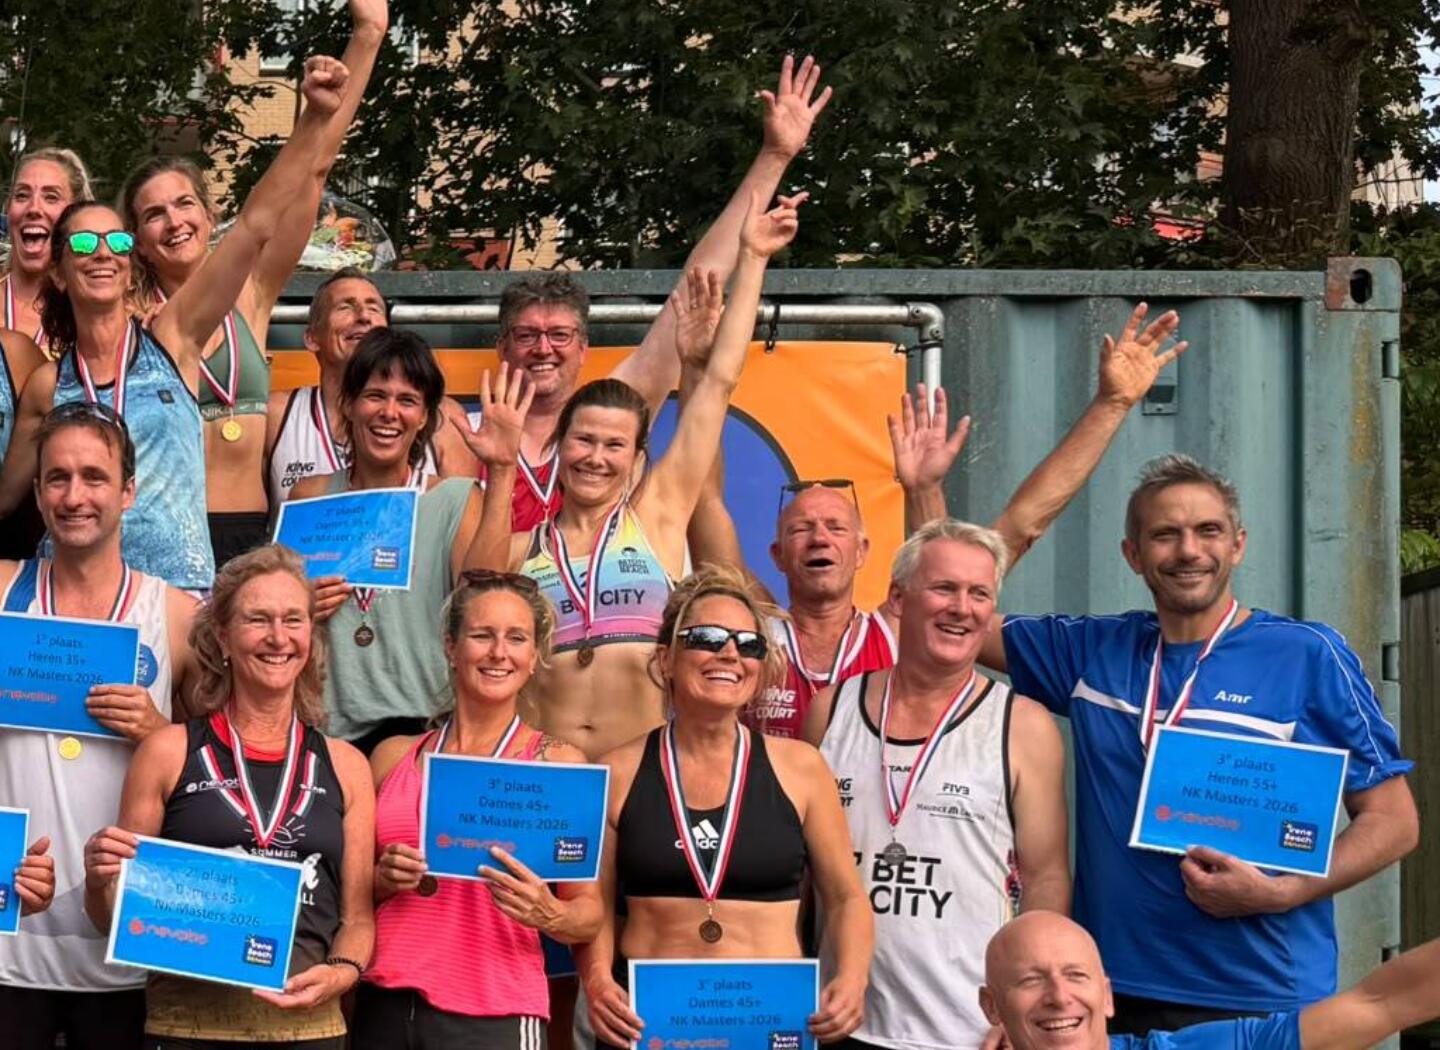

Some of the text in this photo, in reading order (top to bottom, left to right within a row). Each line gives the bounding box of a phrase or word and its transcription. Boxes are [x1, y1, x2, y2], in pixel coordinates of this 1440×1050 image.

[286, 460, 315, 472] KING
[599, 588, 646, 606] CITY
[49, 635, 83, 650] plaats
[28, 651, 86, 666] Heren 35+
[8, 665, 104, 685] NK Masters 2026
[1214, 689, 1252, 704] Amr
[756, 706, 798, 719] COURT
[1234, 755, 1276, 774] plaats
[503, 779, 543, 794] plaats
[1207, 770, 1278, 792] Heren 55+
[479, 796, 549, 812] Dames 45+
[1182, 785, 1299, 815] NK Masters 2026
[458, 813, 568, 831] NK Masters 2026
[202, 868, 240, 886] plaats
[871, 852, 942, 887] BET
[222, 892, 243, 905] 45+
[869, 885, 953, 919] CITY
[176, 902, 226, 922] Masters
[230, 912, 261, 927] 2026
[713, 978, 753, 993] plaats
[688, 996, 761, 1009] Dames 45+
[670, 1013, 781, 1027] NK Masters 2026
